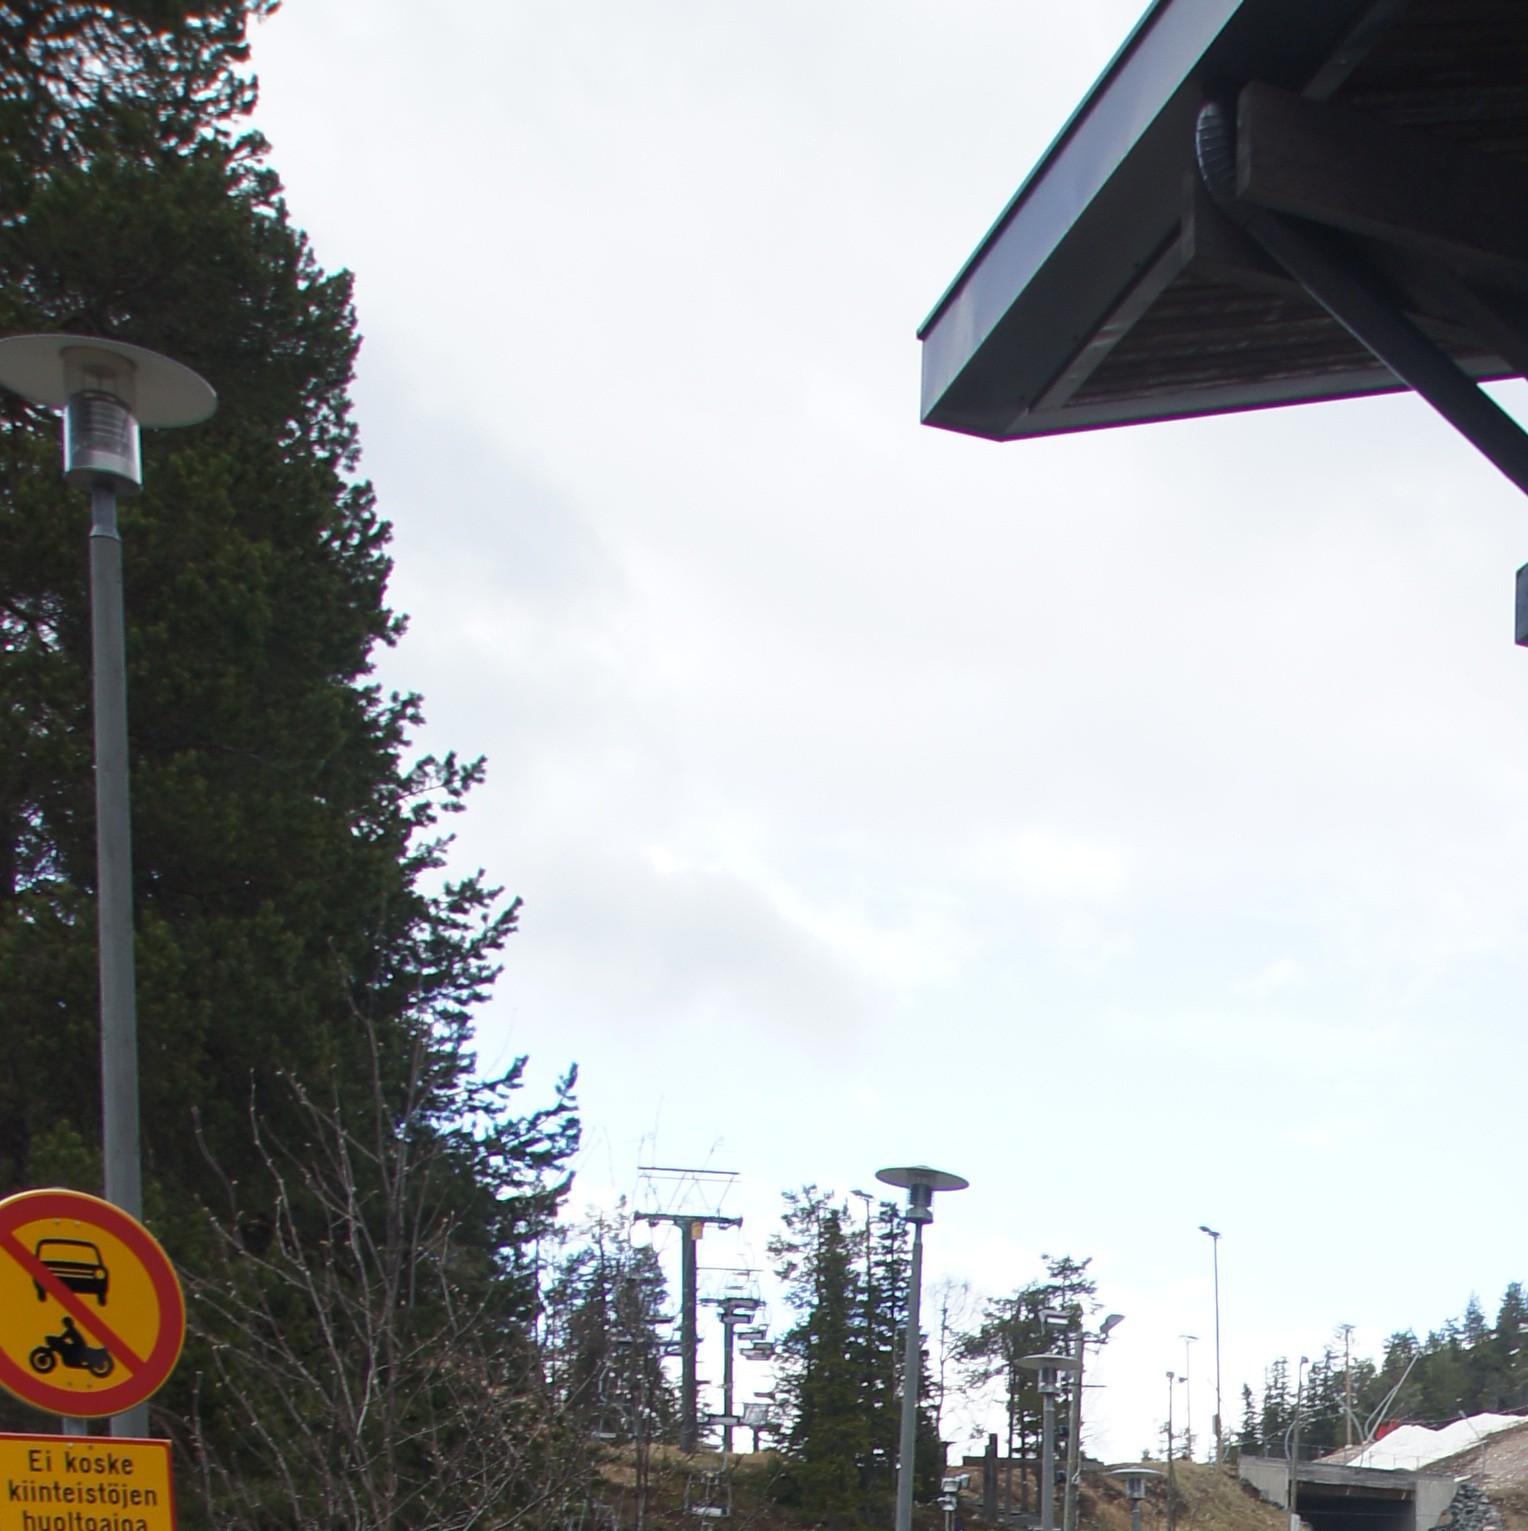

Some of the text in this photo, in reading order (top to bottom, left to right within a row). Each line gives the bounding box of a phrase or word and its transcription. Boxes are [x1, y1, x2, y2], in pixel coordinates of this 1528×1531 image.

[28, 1449, 134, 1475] Ei koske
[8, 1480, 157, 1508] kiinteistöjen
